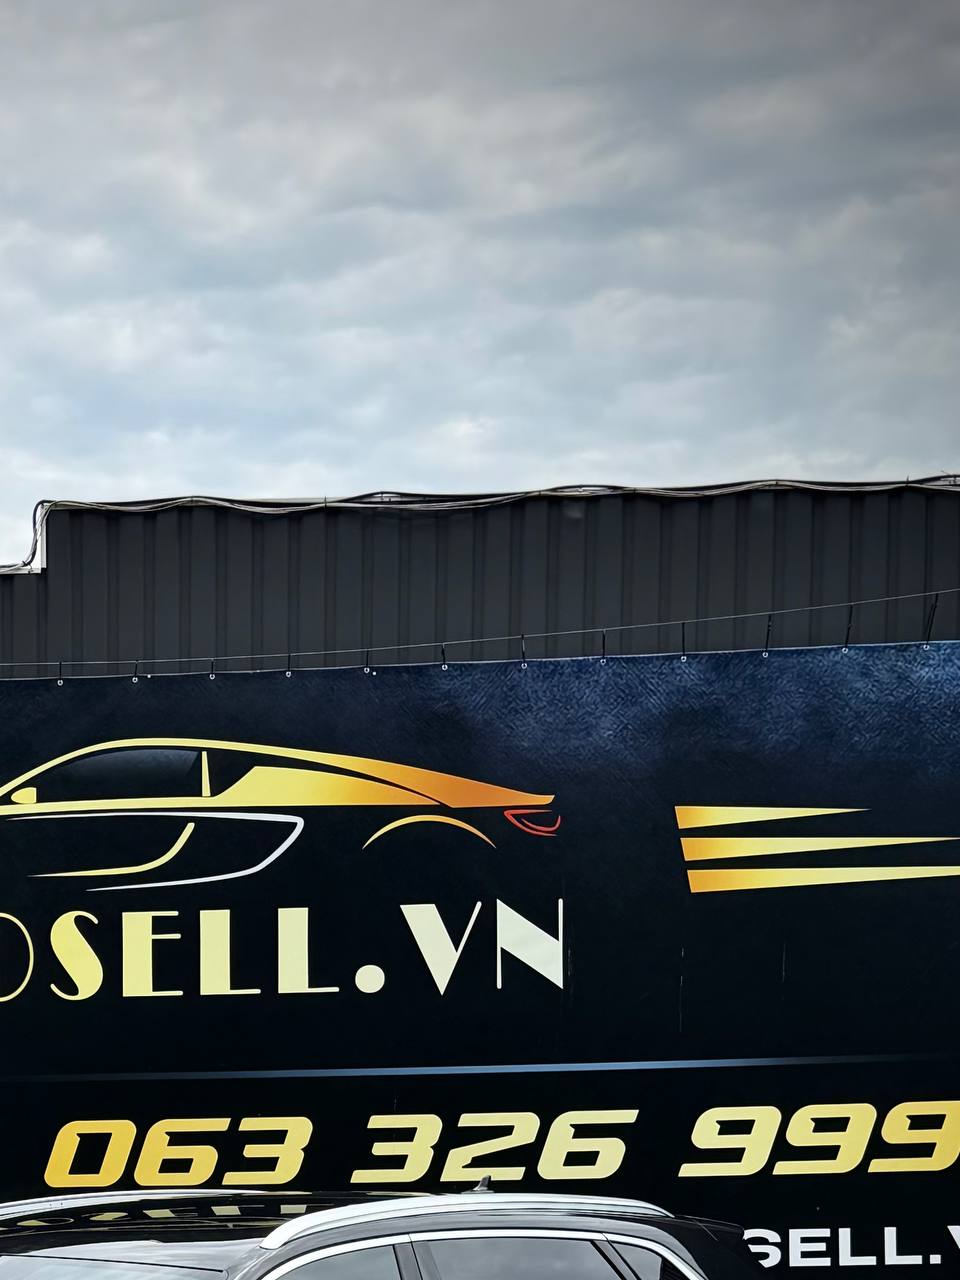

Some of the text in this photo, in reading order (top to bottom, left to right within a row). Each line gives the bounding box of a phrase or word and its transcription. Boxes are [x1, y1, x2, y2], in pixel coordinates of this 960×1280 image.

[43, 1100, 960, 1187] 063 326 999
[742, 1226, 960, 1268] SELL.
